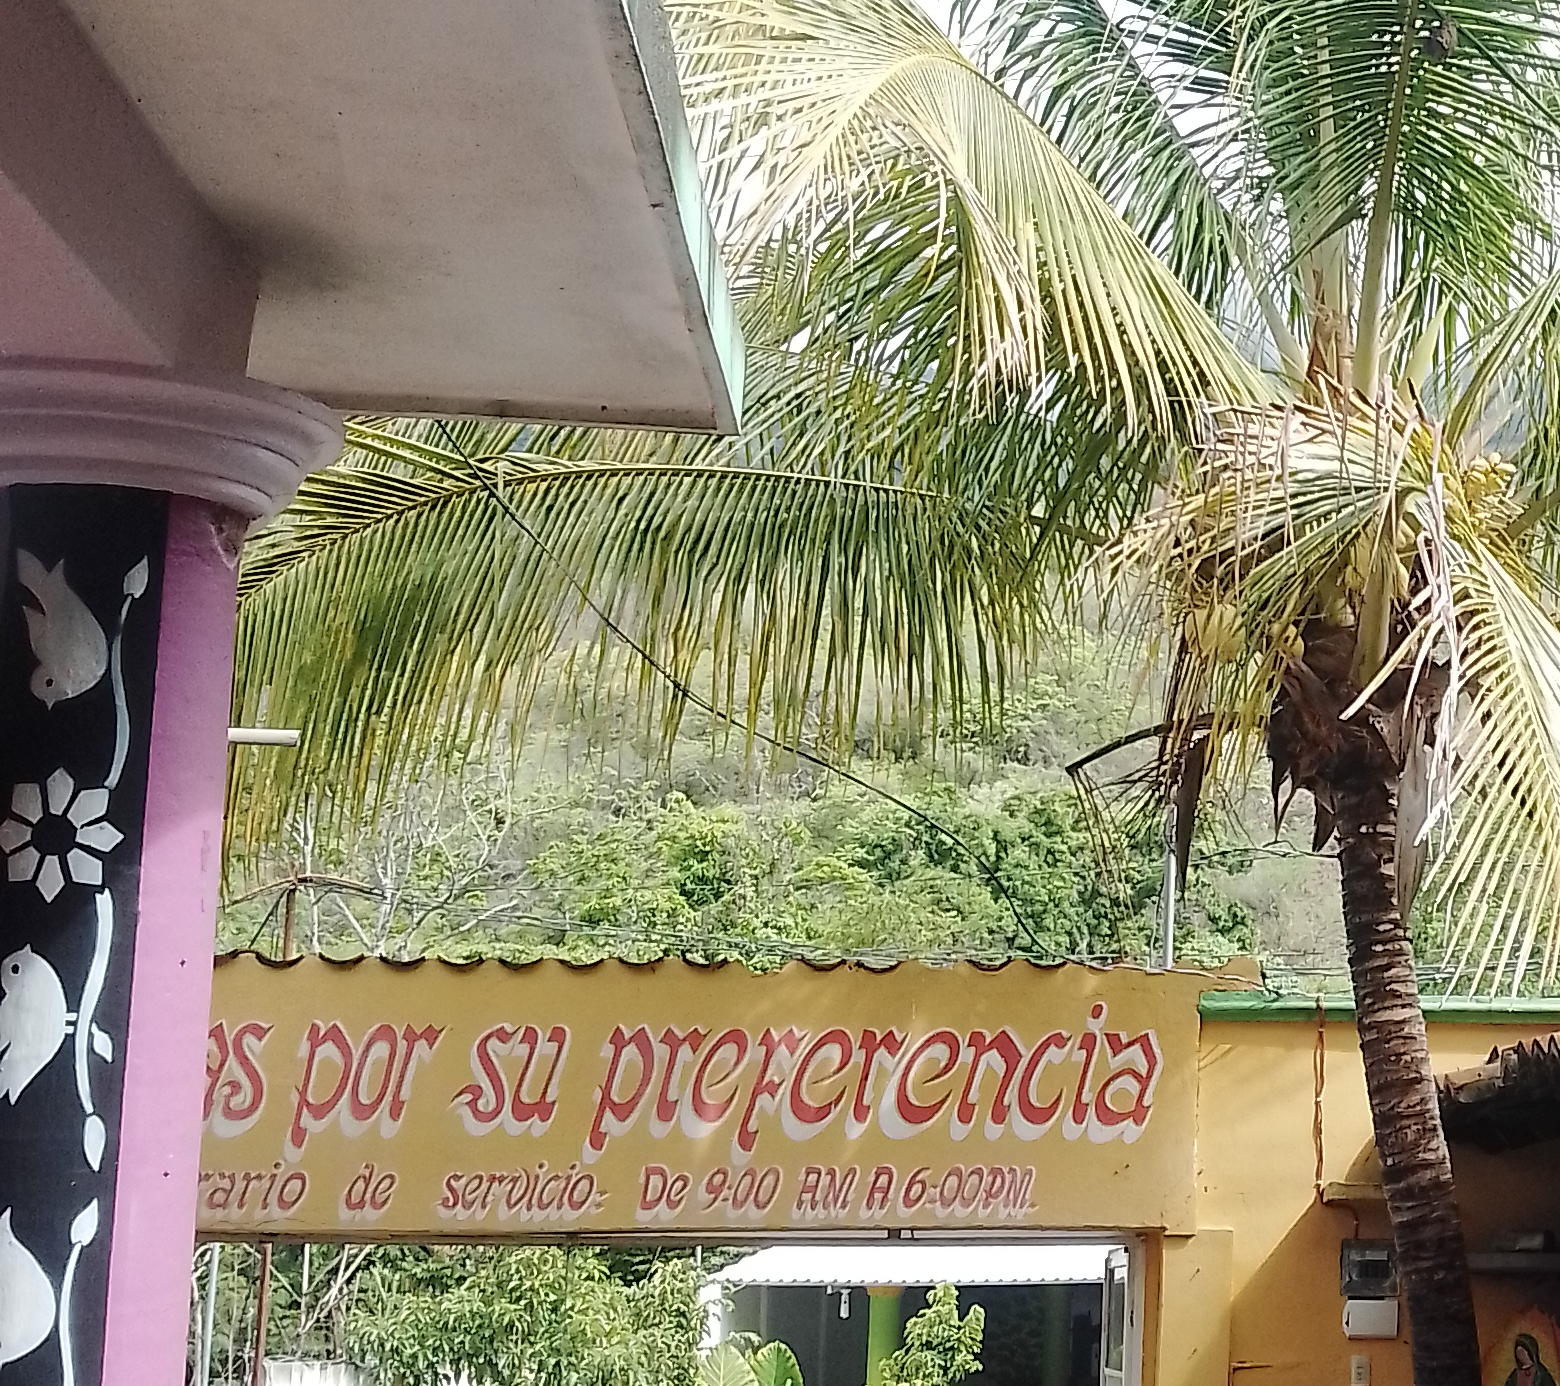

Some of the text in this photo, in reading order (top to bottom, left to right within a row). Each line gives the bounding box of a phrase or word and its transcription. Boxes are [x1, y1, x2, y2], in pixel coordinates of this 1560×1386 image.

[289, 1019, 447, 1151] por
[449, 1021, 563, 1125] su
[586, 1001, 1160, 1154] preferencia
[344, 1162, 398, 1213] de
[638, 1164, 693, 1212] De
[700, 1165, 783, 1213] 9:00
[796, 1165, 860, 1214] AM
[864, 1165, 896, 1213] A
